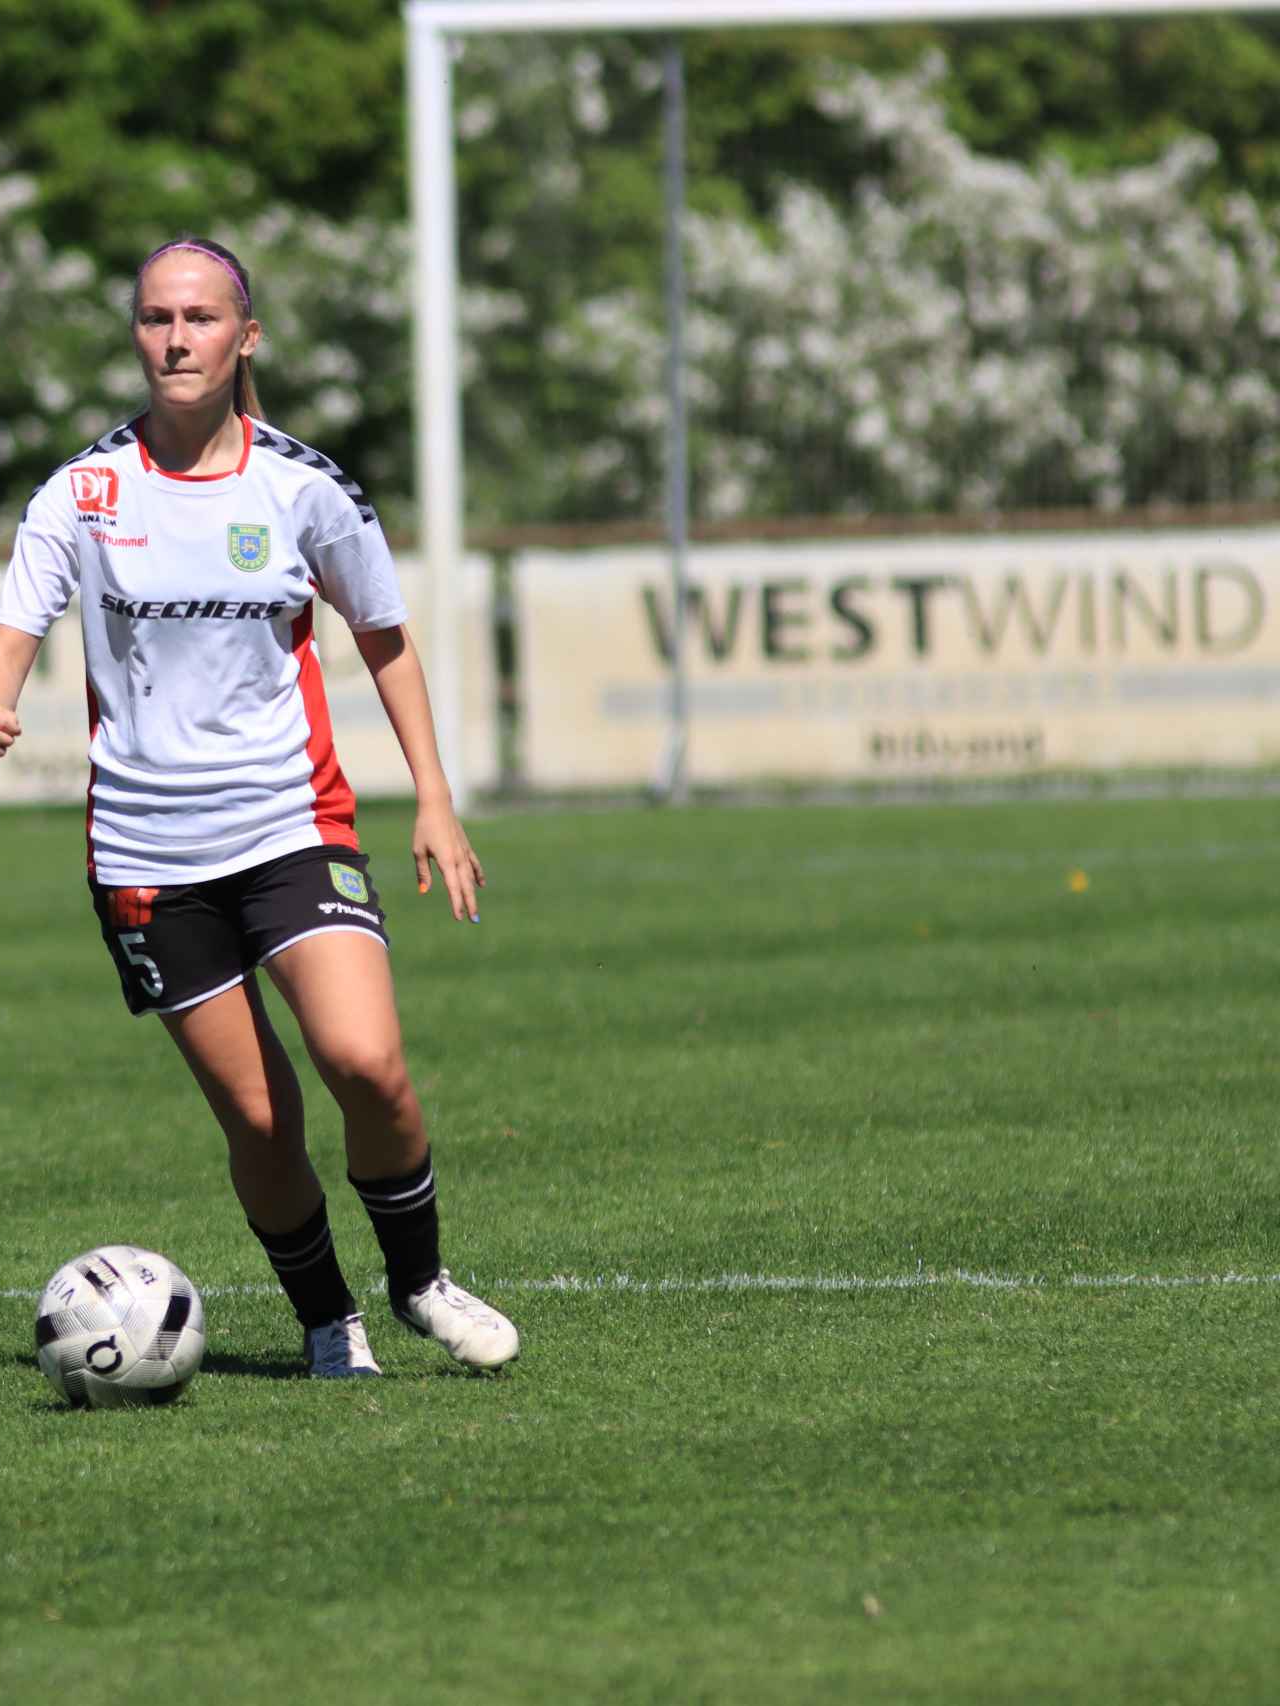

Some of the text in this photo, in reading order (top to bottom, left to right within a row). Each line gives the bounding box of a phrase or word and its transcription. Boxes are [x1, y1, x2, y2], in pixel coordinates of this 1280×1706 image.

[102, 532, 149, 548] hummel
[100, 594, 287, 620] SKECHERS
[118, 931, 164, 998] 5
